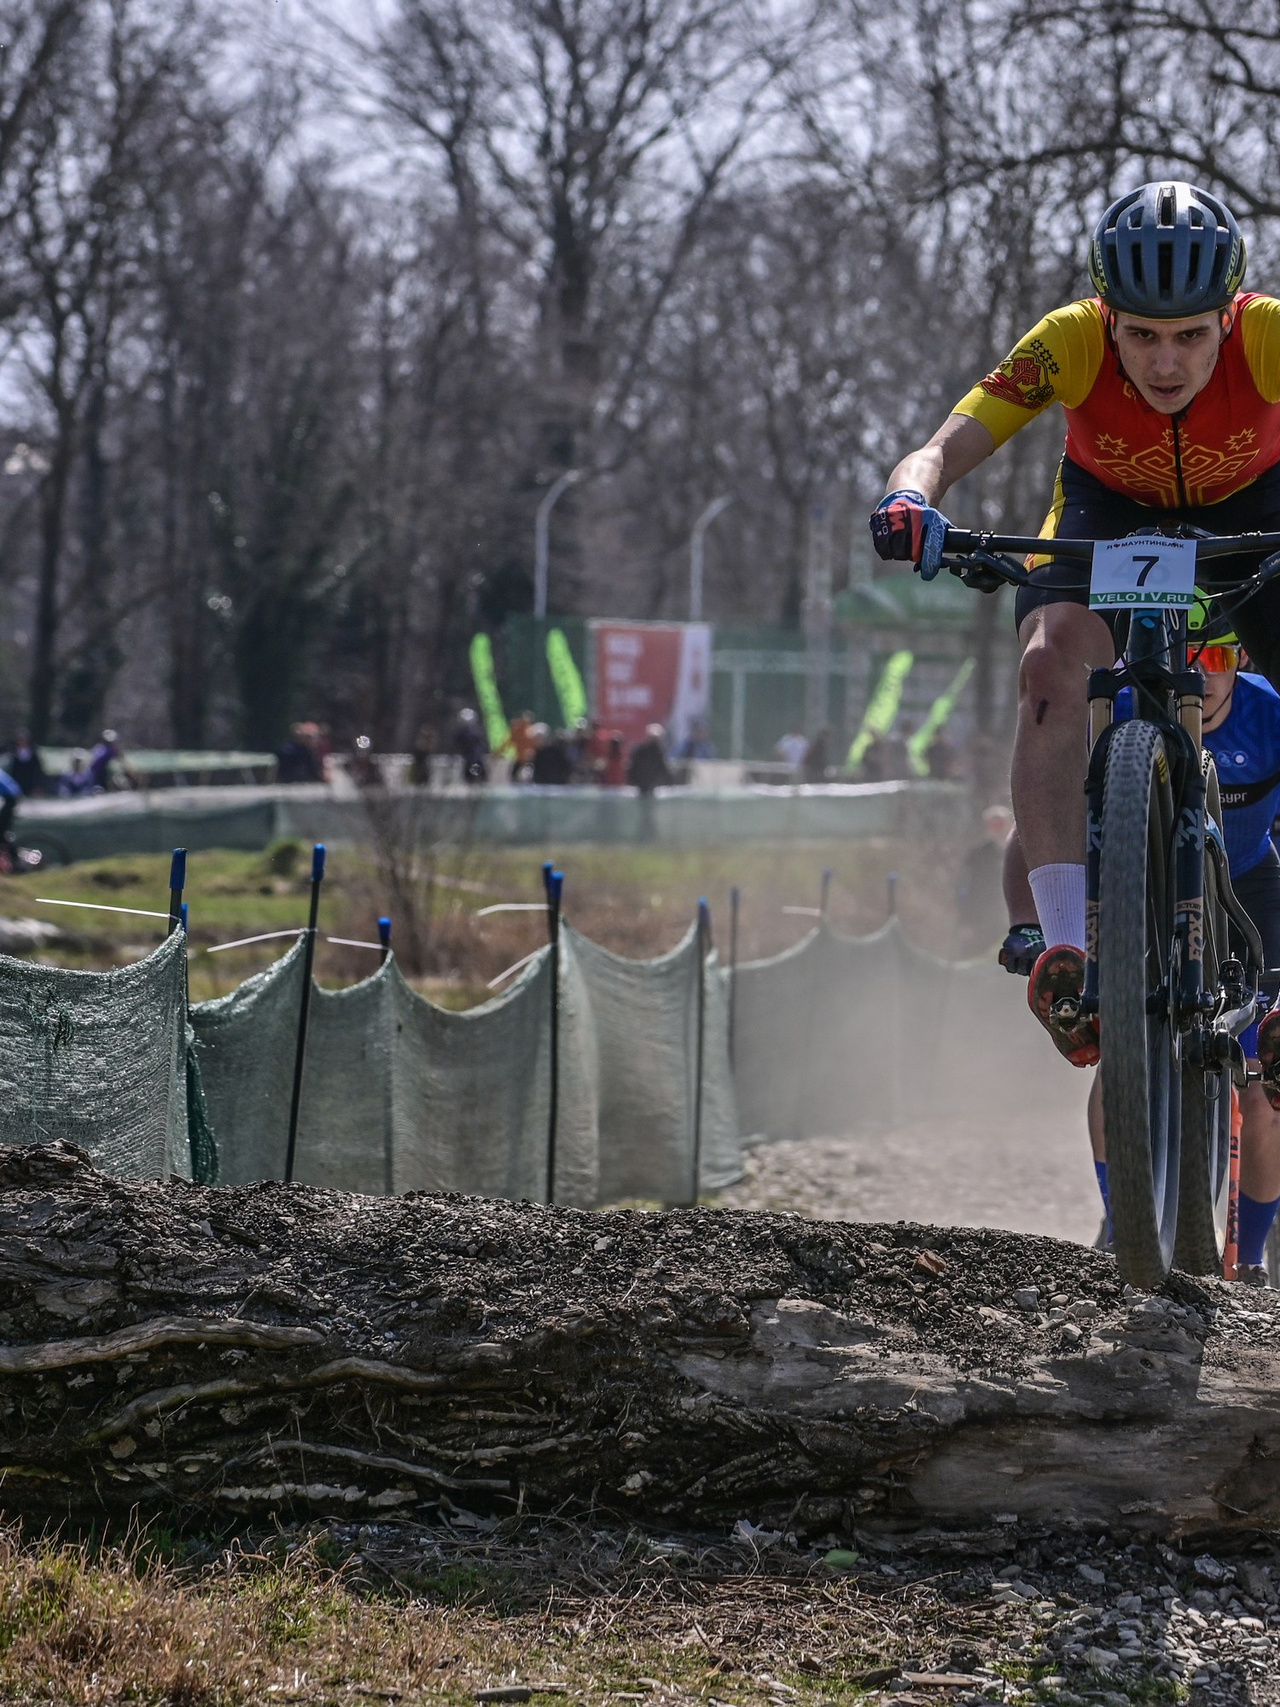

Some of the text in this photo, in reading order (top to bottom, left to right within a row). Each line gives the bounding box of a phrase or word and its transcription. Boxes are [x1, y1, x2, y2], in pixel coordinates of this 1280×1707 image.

[1095, 240, 1109, 289] SCOTT
[1225, 236, 1238, 288] SCOTT
[1132, 555, 1160, 587] 7
[1097, 592, 1188, 603] VELOTV.RU
